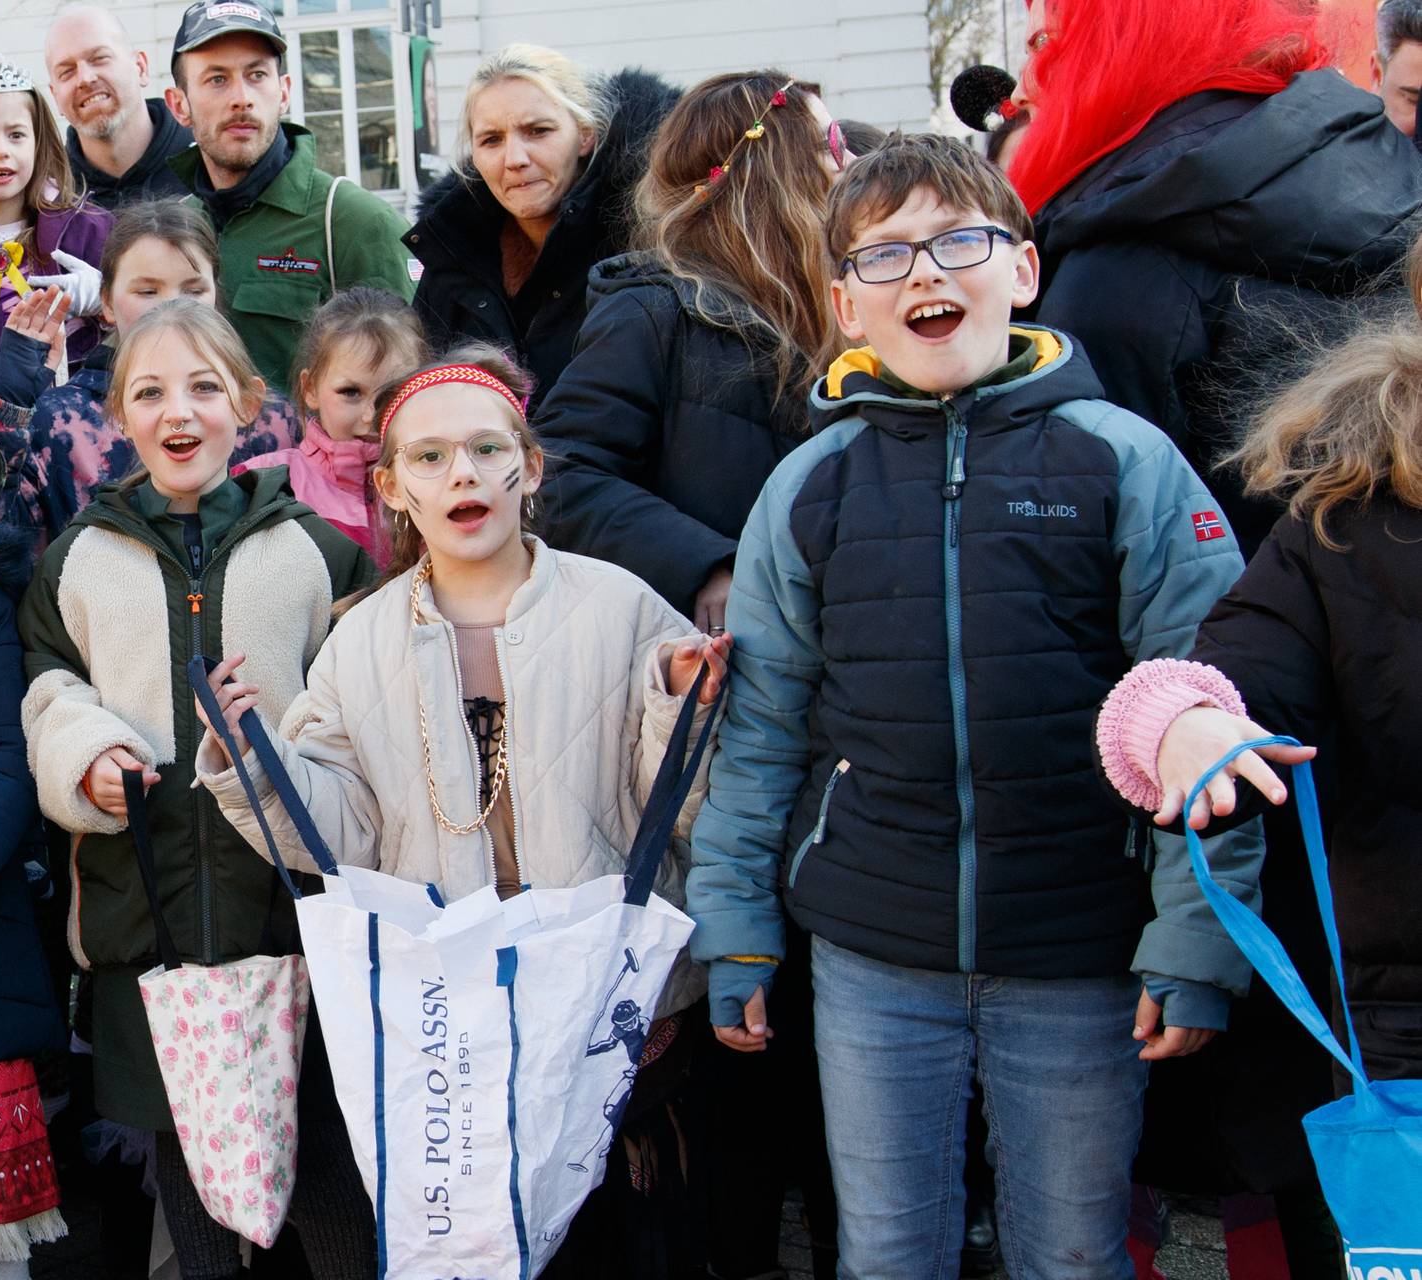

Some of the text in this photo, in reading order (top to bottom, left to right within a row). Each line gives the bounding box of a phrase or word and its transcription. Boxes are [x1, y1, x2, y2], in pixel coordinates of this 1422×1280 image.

[1006, 501, 1077, 518] TROLLKIDS
[421, 976, 452, 1237] U.S. POLO ASSN.
[460, 1101, 472, 1176] SINCE
